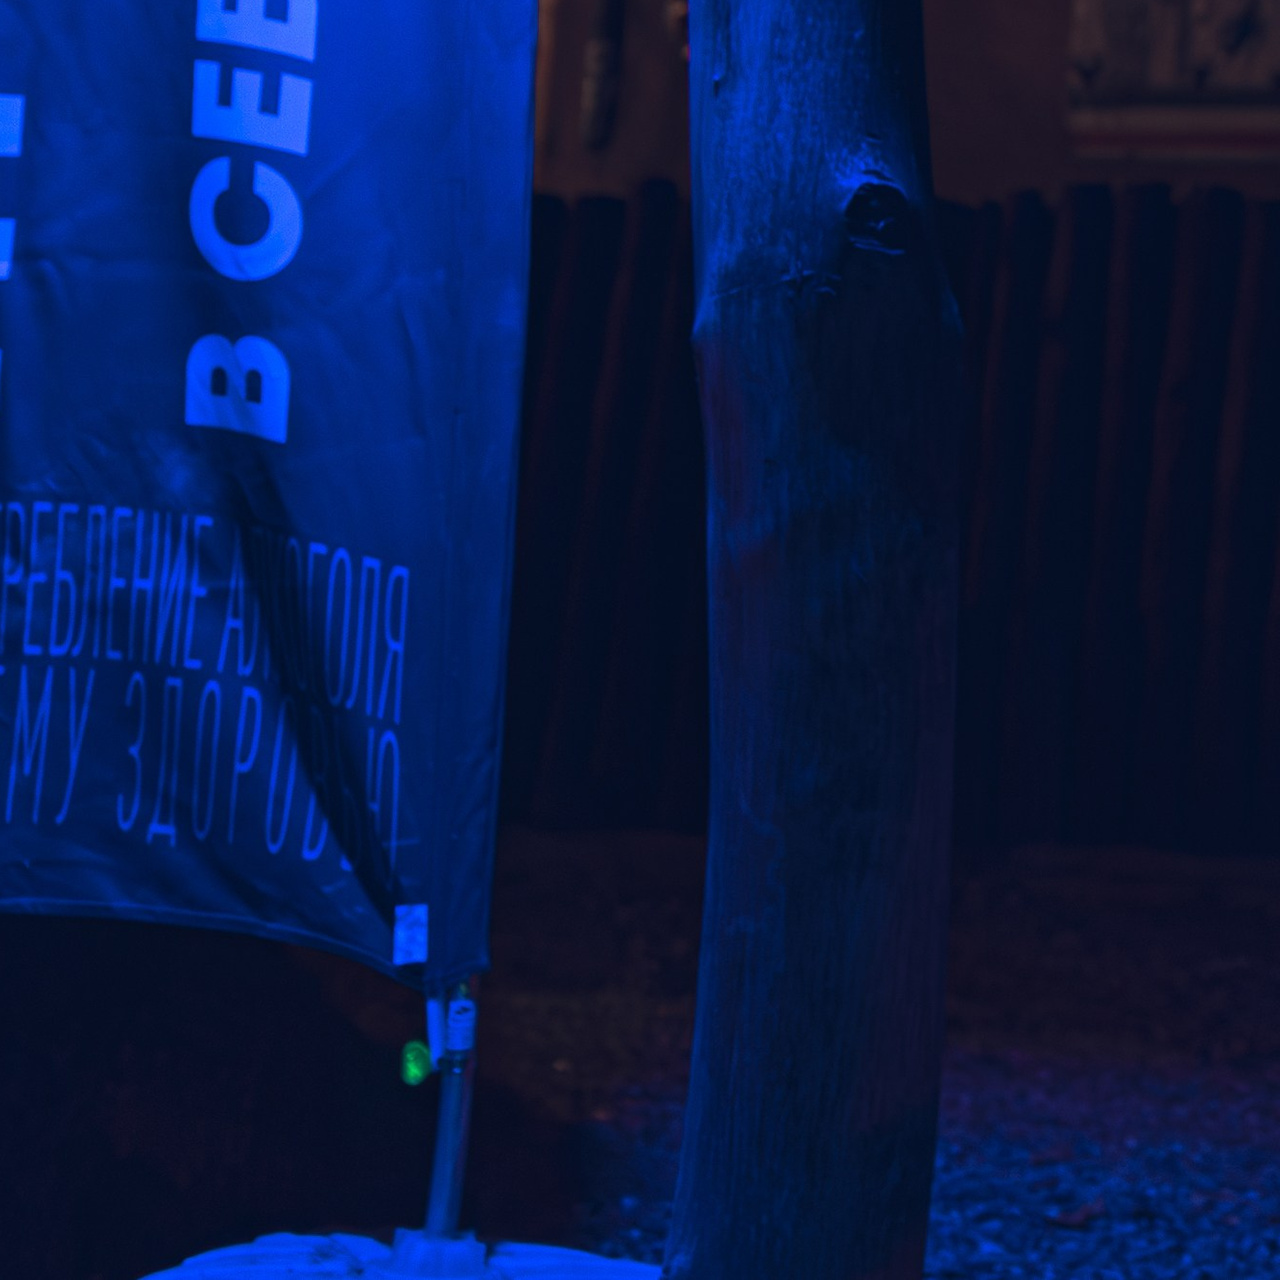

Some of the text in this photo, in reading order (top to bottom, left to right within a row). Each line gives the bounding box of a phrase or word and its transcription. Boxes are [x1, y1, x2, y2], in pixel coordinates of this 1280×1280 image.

[184, 332, 291, 445] В
[0, 500, 214, 670] РЕБЛЕНИЕ
[0, 664, 96, 826] МУ
